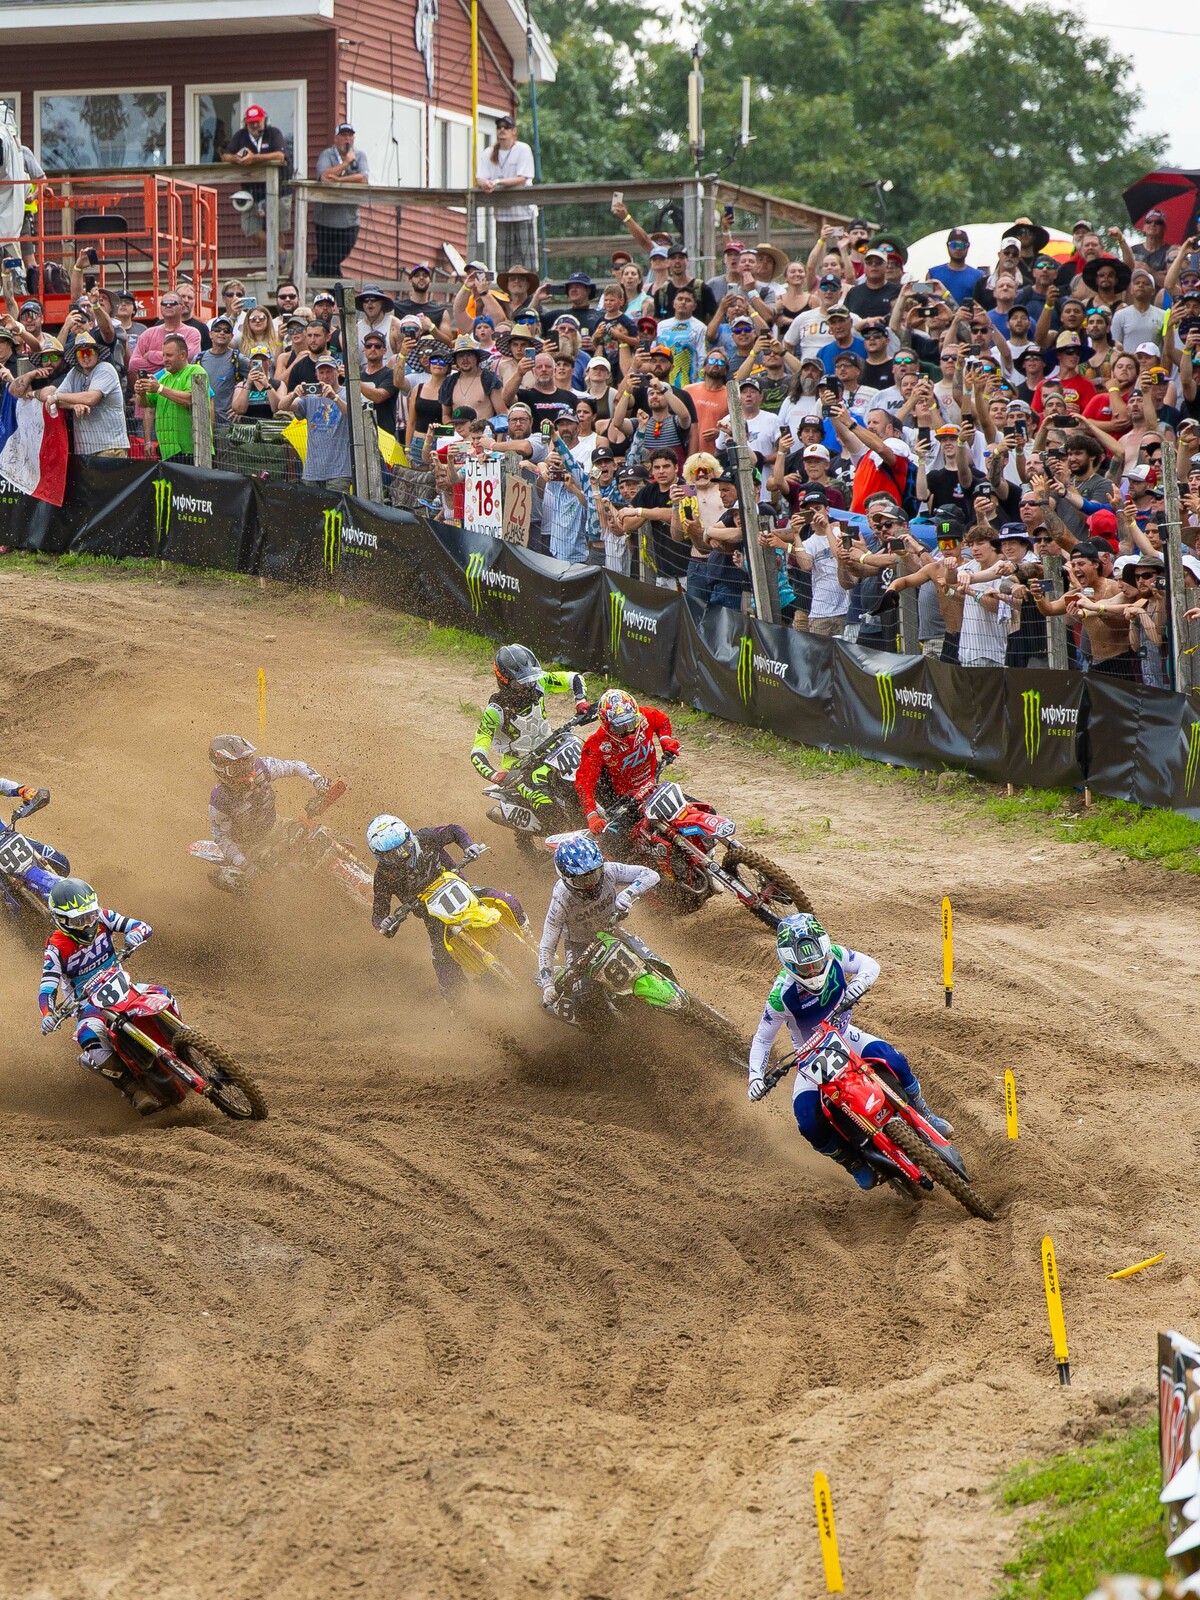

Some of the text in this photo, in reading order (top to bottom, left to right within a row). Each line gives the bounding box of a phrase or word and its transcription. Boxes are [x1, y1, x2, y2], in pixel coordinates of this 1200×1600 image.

[802, 321, 836, 338] FUC
[467, 457, 498, 477] JETT
[171, 488, 214, 516] MONSTER
[475, 479, 494, 517] 18
[509, 481, 527, 527] 23
[177, 512, 208, 524] ENERGY
[341, 526, 379, 550] MONSTER
[481, 568, 521, 594] MONSTER
[487, 589, 517, 602] ENERGY
[622, 608, 658, 635] MONSTER
[627, 630, 652, 644] ENERGY
[753, 652, 789, 680] MONSTER
[758, 674, 780, 688] ENERGY
[895, 685, 934, 711] MONSTER
[901, 709, 927, 721] ENERGY
[1040, 704, 1079, 726] MONSTE
[471, 755, 493, 777] FXR
[621, 740, 652, 774] FLY
[650, 784, 684, 821] 107
[508, 806, 531, 828] 489
[438, 884, 472, 917] 11
[66, 932, 109, 974] FXR
[77, 953, 109, 977] MOTO
[603, 948, 638, 989] 81
[96, 971, 131, 1009] 87
[810, 1040, 851, 1086] 23
